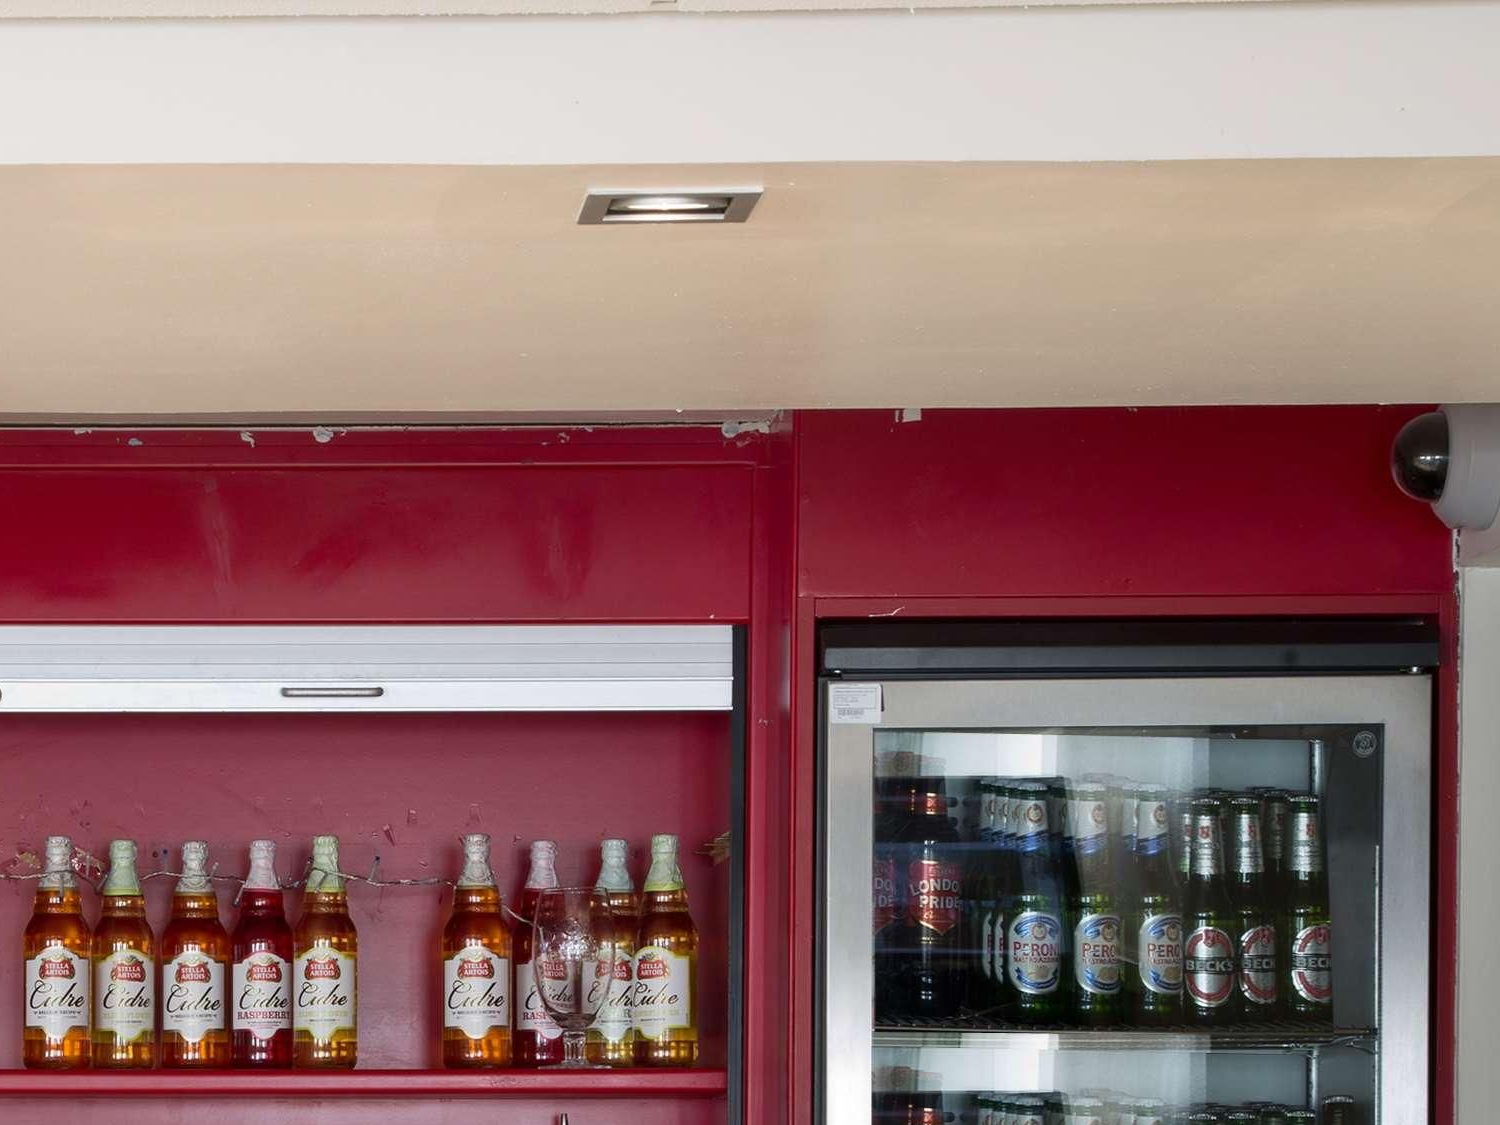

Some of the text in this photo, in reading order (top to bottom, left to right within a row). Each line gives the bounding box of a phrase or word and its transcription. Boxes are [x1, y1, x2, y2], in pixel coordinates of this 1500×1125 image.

[910, 878, 961, 896] LONDO
[1185, 960, 1234, 972] BECK'S
[30, 980, 85, 1009] Cidre
[103, 984, 150, 1009] Cidre
[167, 985, 221, 1013] Cidre
[240, 985, 289, 1009] Cidre
[299, 982, 348, 1007] Cidre
[448, 980, 505, 1009] Cidre
[632, 982, 678, 1007] Cidre
